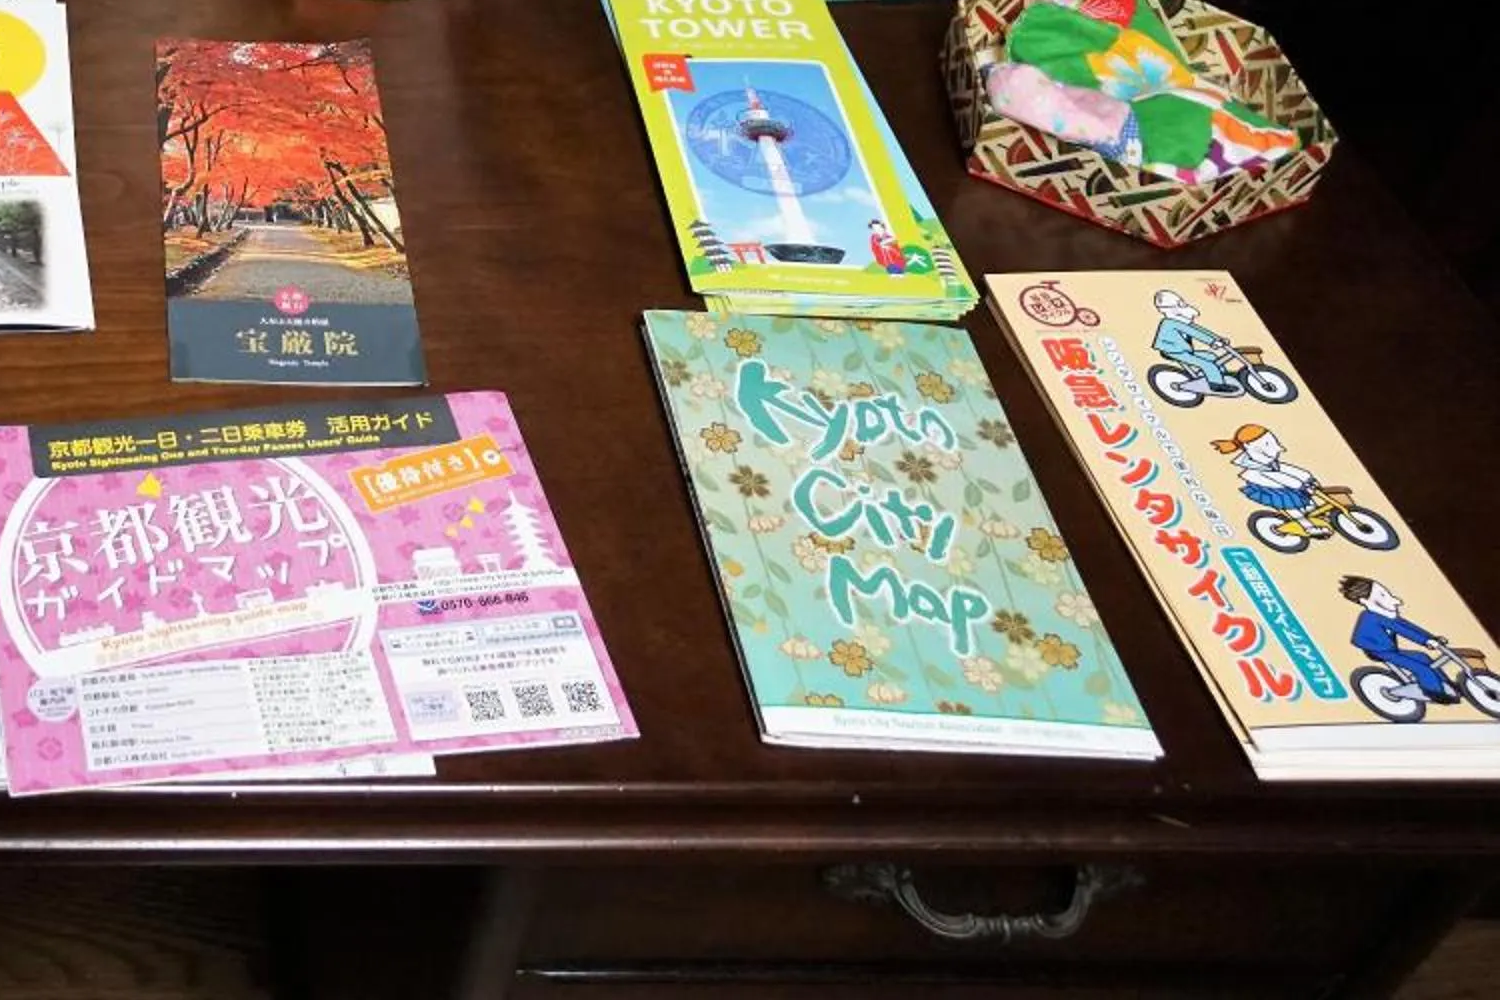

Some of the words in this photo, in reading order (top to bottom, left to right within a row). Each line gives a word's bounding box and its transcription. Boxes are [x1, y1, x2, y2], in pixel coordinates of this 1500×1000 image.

[639, 18, 815, 41] TOWER
[326, 411, 433, 435] 活用ガイド
[736, 358, 958, 461] Kyoto
[19, 475, 330, 587] 京都観光
[793, 467, 957, 562] City
[24, 533, 350, 621] ガイドマップ
[827, 554, 990, 656] Map
